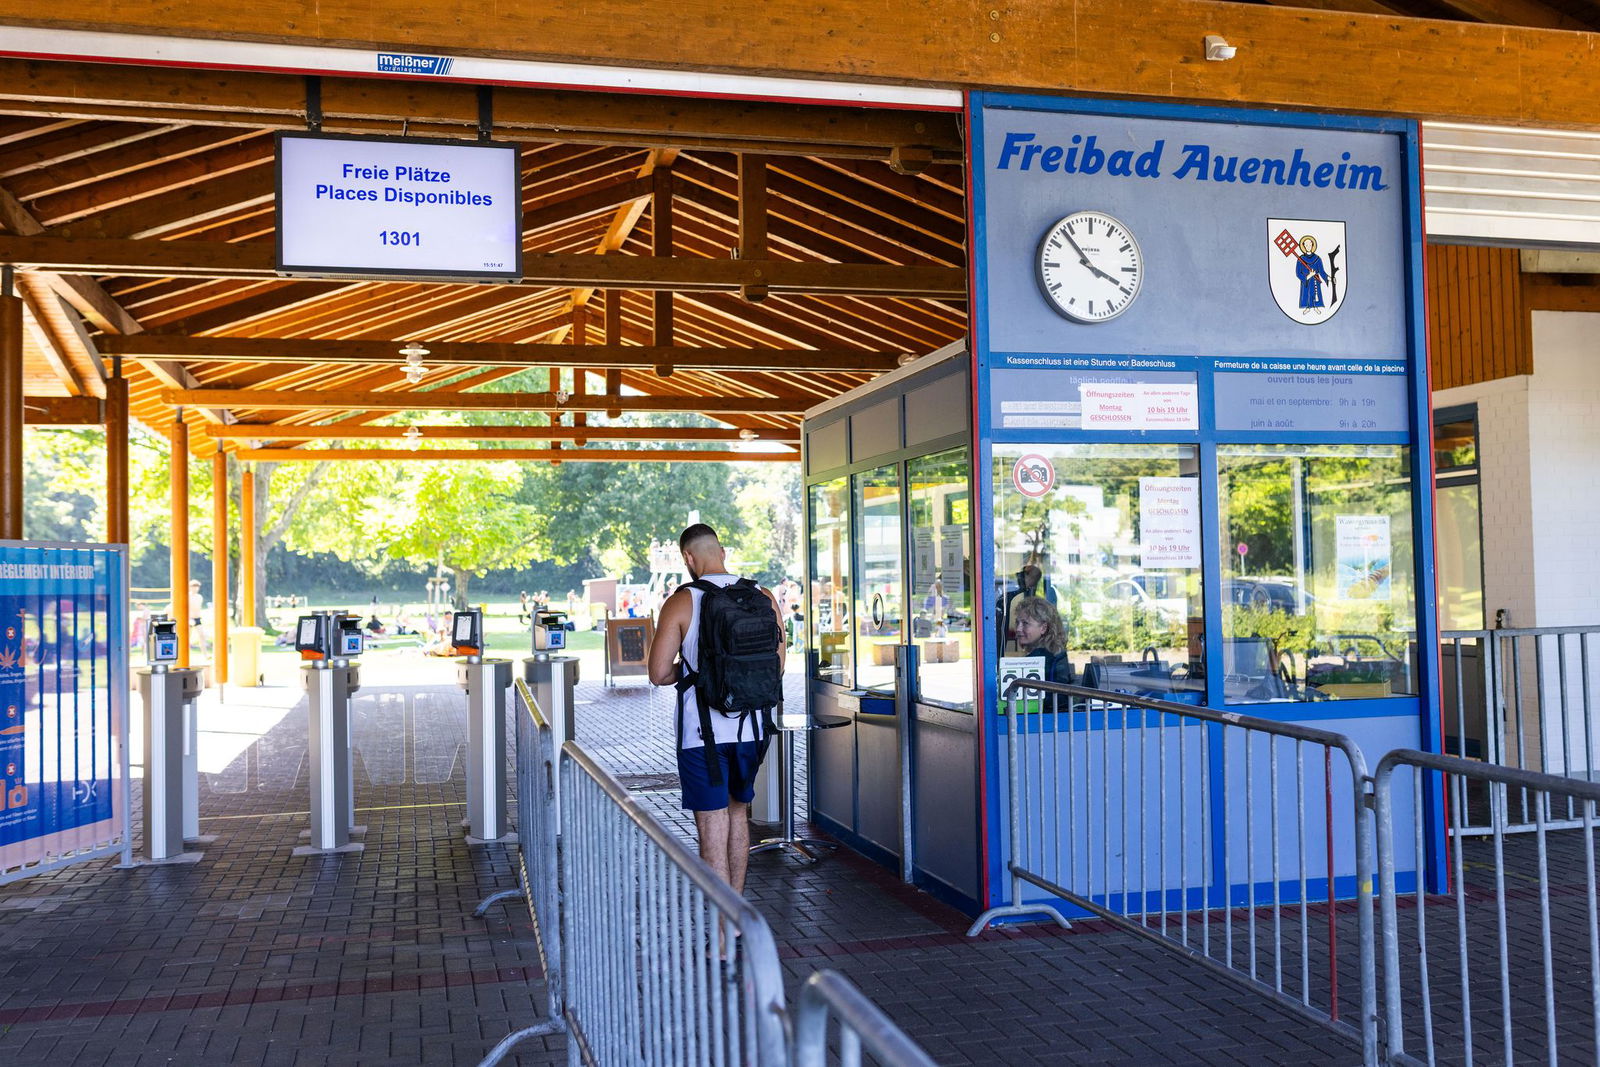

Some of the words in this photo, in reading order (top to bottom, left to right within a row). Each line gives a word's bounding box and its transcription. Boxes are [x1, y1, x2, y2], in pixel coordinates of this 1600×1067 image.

[997, 132, 1164, 178] Freibad
[1172, 144, 1388, 191] Auenheim
[342, 163, 389, 180] Freie
[395, 166, 451, 183] Plätze
[316, 184, 378, 201] Places
[384, 187, 493, 206] Disponibles
[379, 230, 420, 246] 1301
[1006, 356, 1061, 366] Kassenschluss
[1063, 357, 1072, 366] ist
[1073, 358, 1089, 366] eine
[1090, 358, 1116, 367] Stunde
[1131, 359, 1176, 368] Badeschluss
[1214, 360, 1249, 369] Fermeture
[1251, 361, 1260, 369] de
[1269, 362, 1291, 370] caisse
[1306, 363, 1326, 371] heure
[1347, 363, 1363, 372] celle
[1364, 364, 1373, 372] de
[1374, 364, 1381, 372] la
[1382, 364, 1405, 373] piscine
[1297, 376, 1315, 384] tous
[1317, 375, 1330, 384] les
[1331, 376, 1353, 386] jours
[1086, 390, 1135, 399] Öffnungszeiten
[1266, 398, 1275, 406] et
[1361, 399, 1376, 407] 19h
[1250, 419, 1265, 429] juin
[1267, 419, 1273, 427] à
[1361, 420, 1377, 428] 20h
[50, 562, 95, 579] INTÉRIEUR
